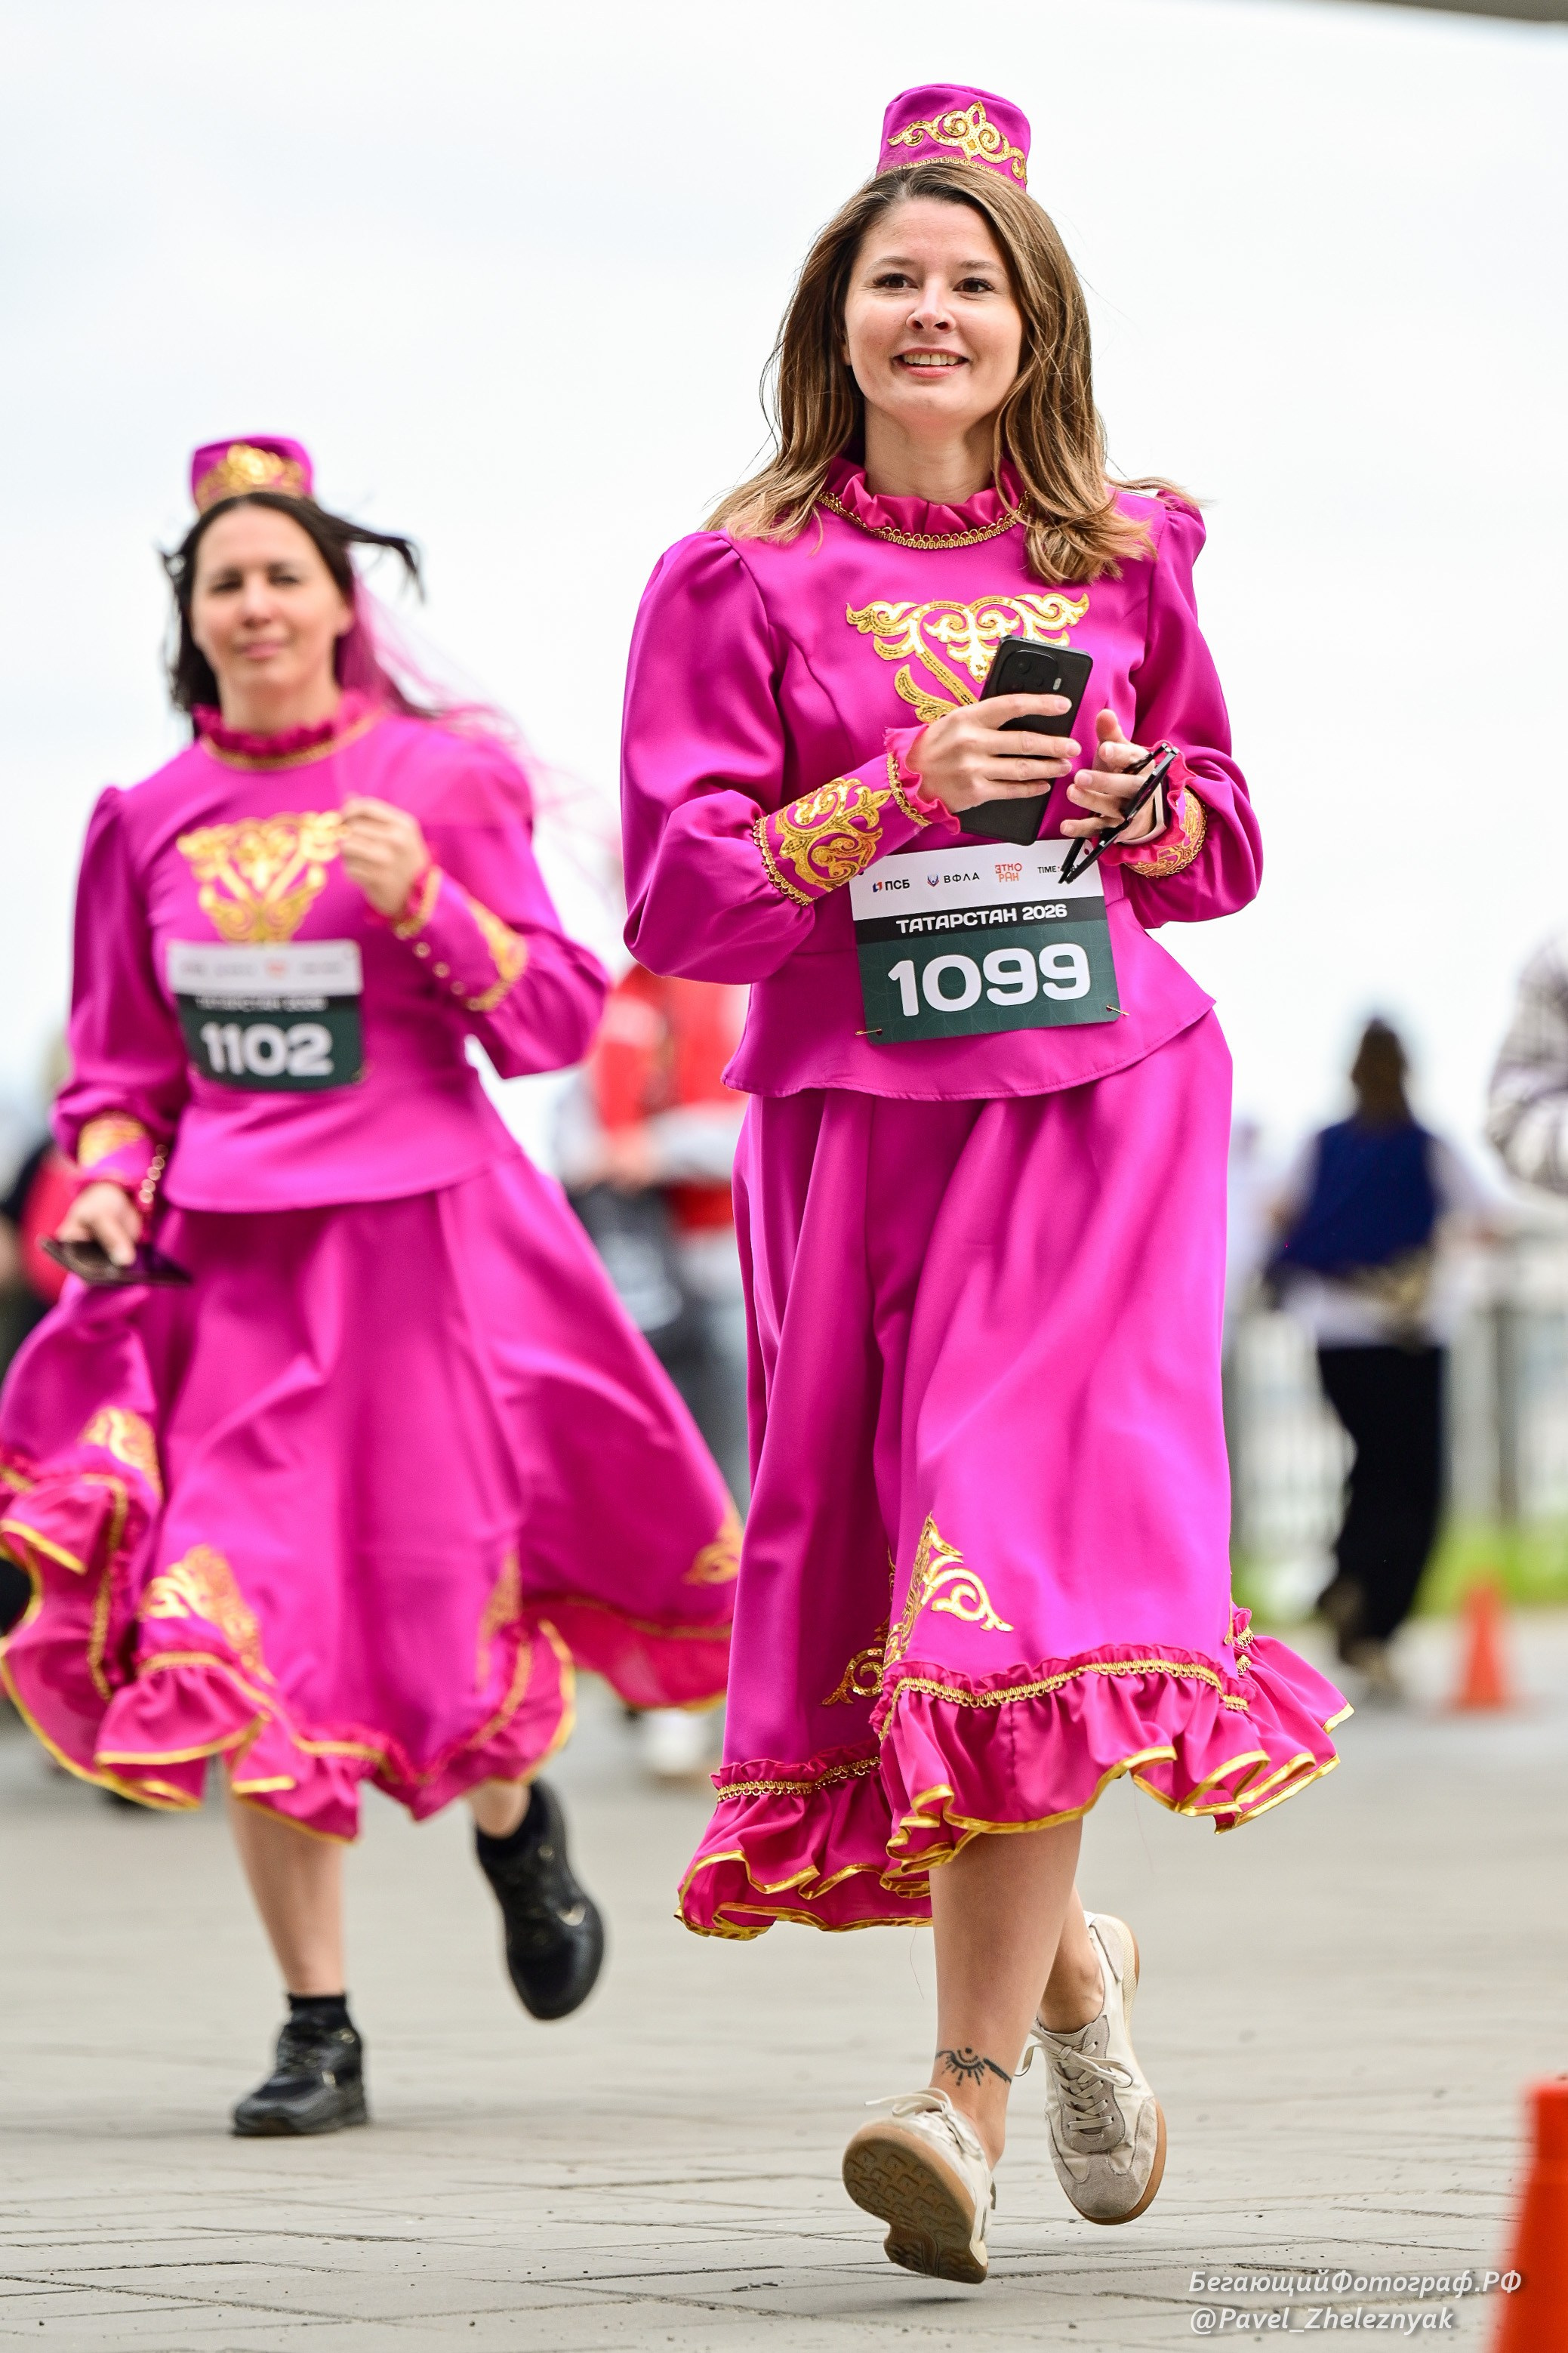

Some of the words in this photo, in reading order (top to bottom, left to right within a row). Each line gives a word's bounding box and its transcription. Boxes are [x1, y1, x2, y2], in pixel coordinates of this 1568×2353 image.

[885, 879, 910, 890] ПСБ
[944, 872, 980, 883] ВФЛА
[999, 872, 1019, 883] РАН
[895, 908, 1017, 934] ТАТАРСТАН
[1021, 903, 1068, 921] 2026
[887, 942, 1092, 1017] 1099
[200, 1022, 334, 1078] 1102
